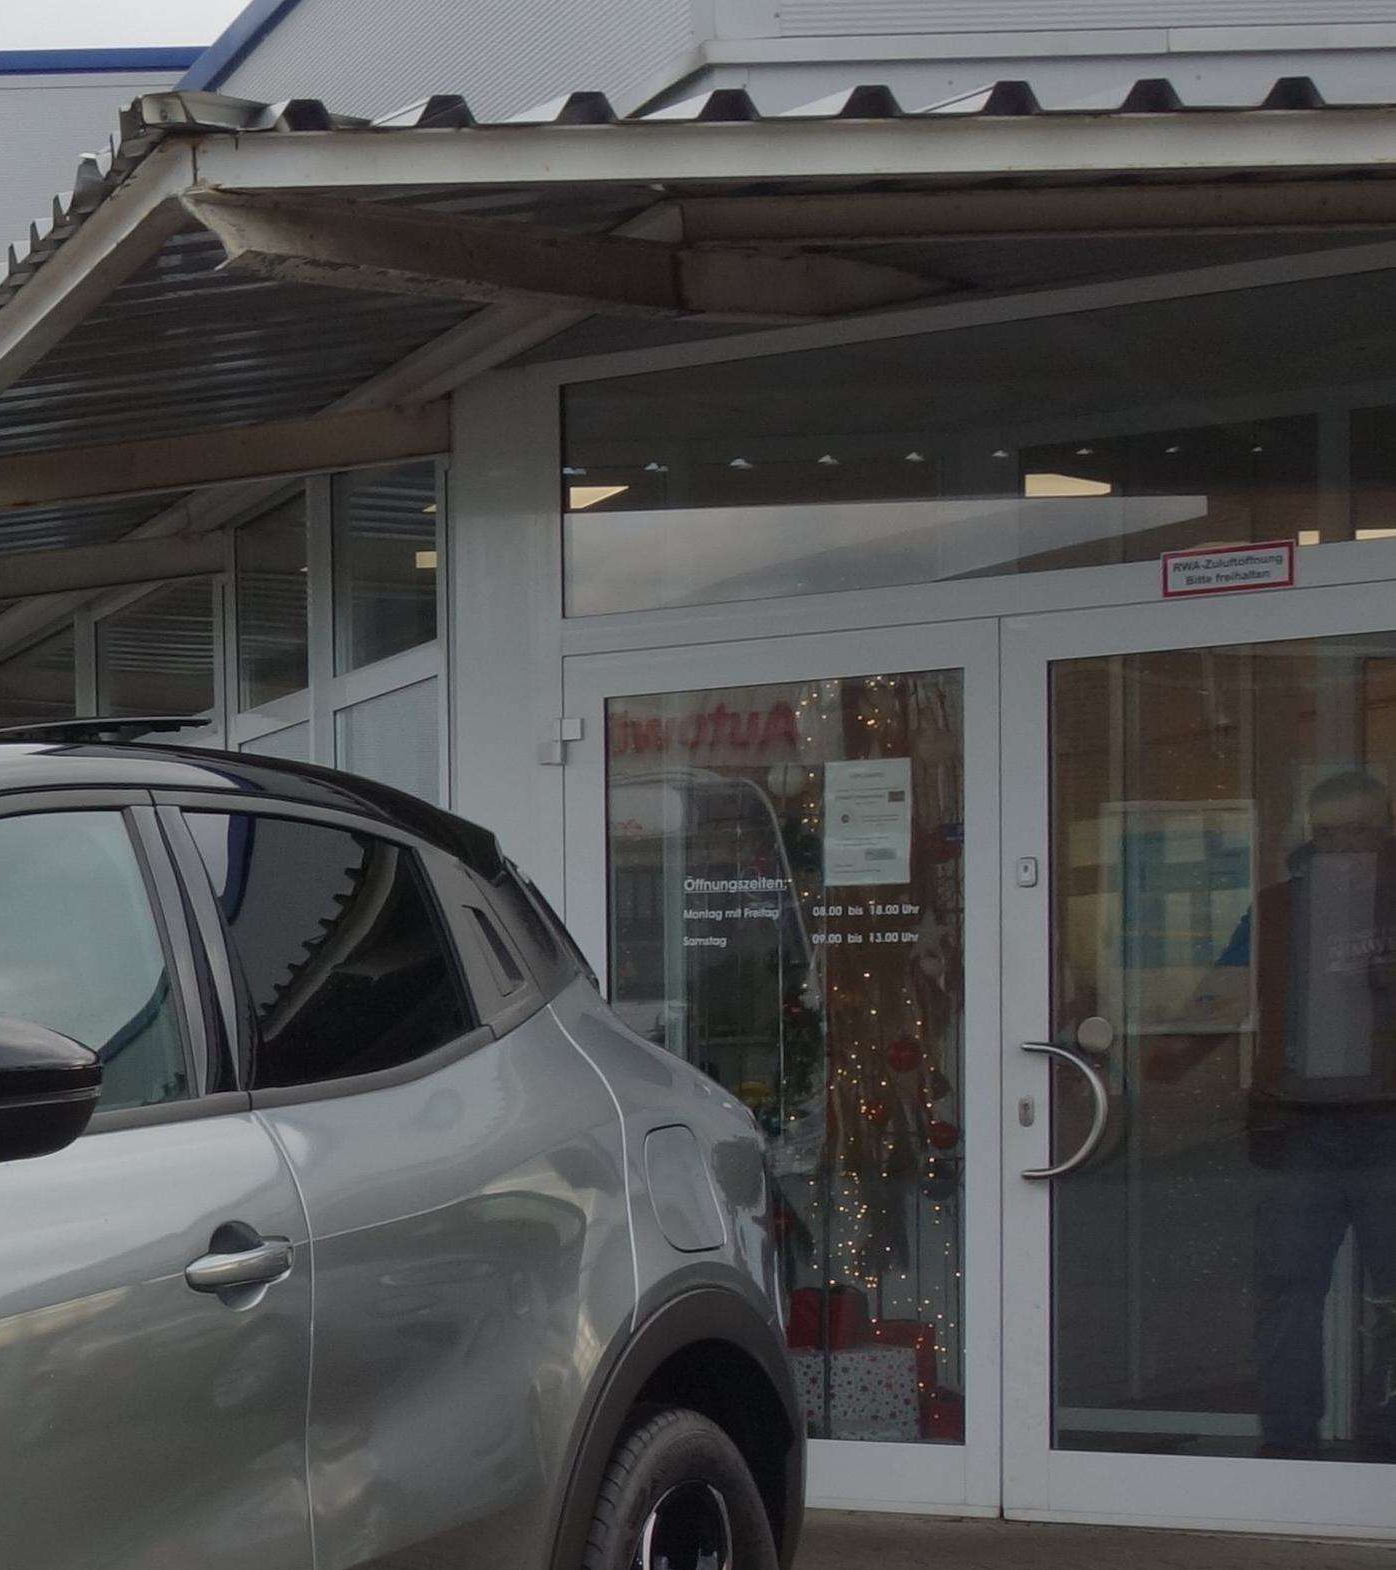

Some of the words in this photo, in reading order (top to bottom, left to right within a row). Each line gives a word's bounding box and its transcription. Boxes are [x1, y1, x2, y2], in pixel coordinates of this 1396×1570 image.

[1186, 573, 1212, 585] Bitte
[1216, 570, 1270, 583] freihalten
[683, 908, 723, 921] Montag
[744, 907, 780, 921] Freitag
[848, 905, 864, 916] bis
[901, 903, 920, 915] Uhr
[683, 936, 728, 948] Samstag
[847, 932, 863, 944] bis
[901, 931, 920, 943] Uhr
